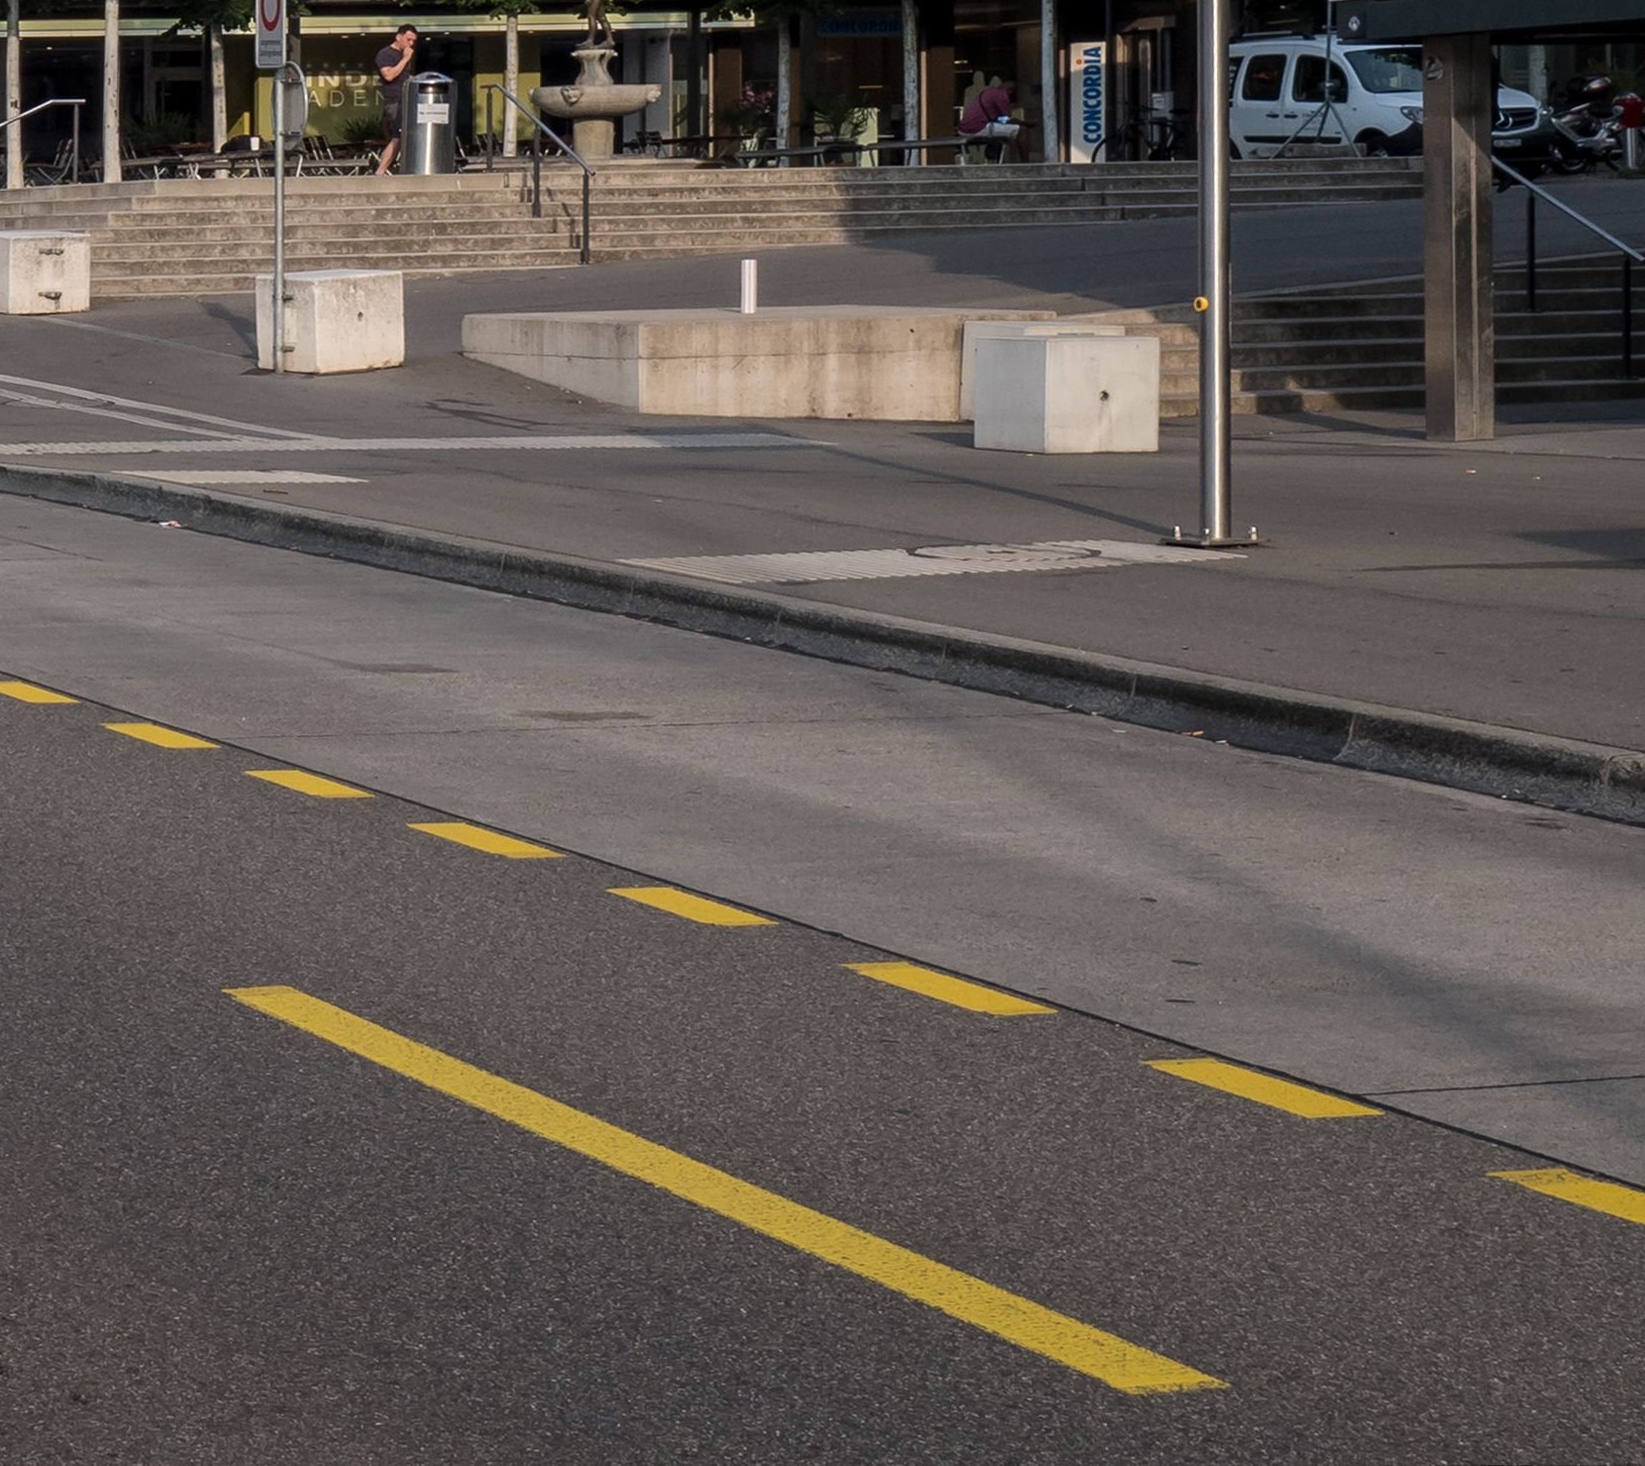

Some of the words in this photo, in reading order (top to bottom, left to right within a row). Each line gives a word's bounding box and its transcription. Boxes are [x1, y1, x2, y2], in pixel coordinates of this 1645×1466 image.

[306, 71, 384, 87] INDE
[308, 90, 389, 107] ADEN
[1082, 46, 1102, 144] CONCORDIA
